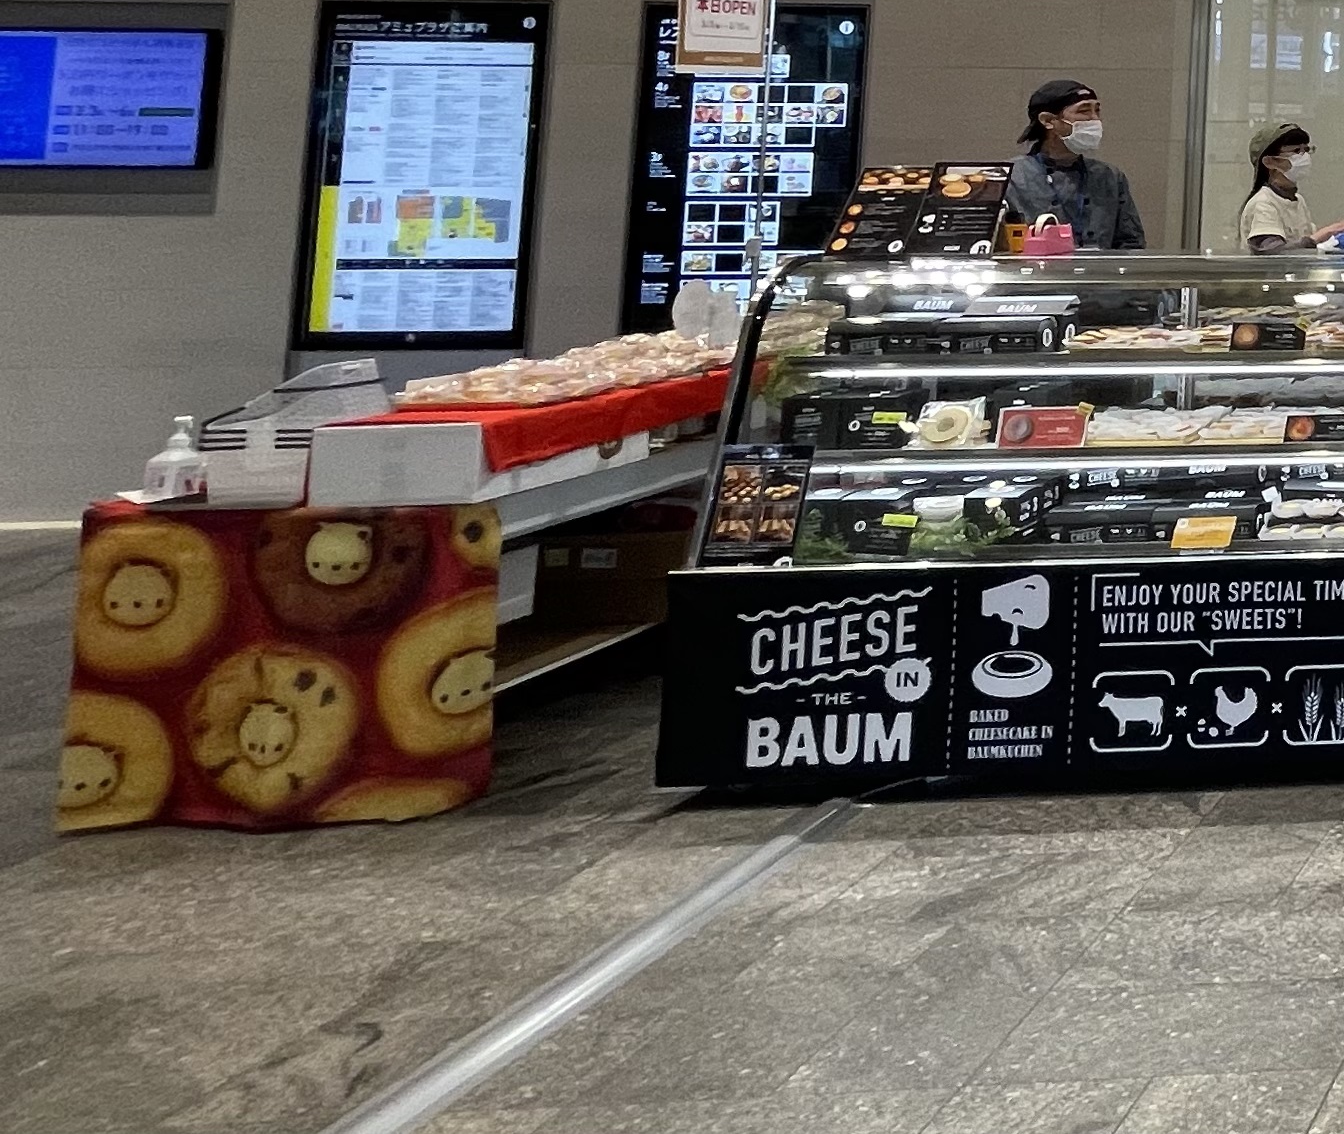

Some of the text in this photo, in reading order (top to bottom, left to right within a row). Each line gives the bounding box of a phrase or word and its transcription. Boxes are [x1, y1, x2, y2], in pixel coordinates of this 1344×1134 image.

[1102, 584, 1164, 607] ENJOY
[1170, 582, 1221, 605] YOUR
[1227, 580, 1307, 603] SPECIAL
[1101, 612, 1149, 634] WITH
[1156, 610, 1196, 633] OUR
[749, 604, 919, 676] CHEESE
[894, 671, 920, 688] IN
[969, 708, 1010, 723] BAKED
[745, 711, 913, 769] BAUM
[968, 725, 1055, 742] CHEESECAKE IN
[967, 744, 1044, 760] BAUMKUCHEN
